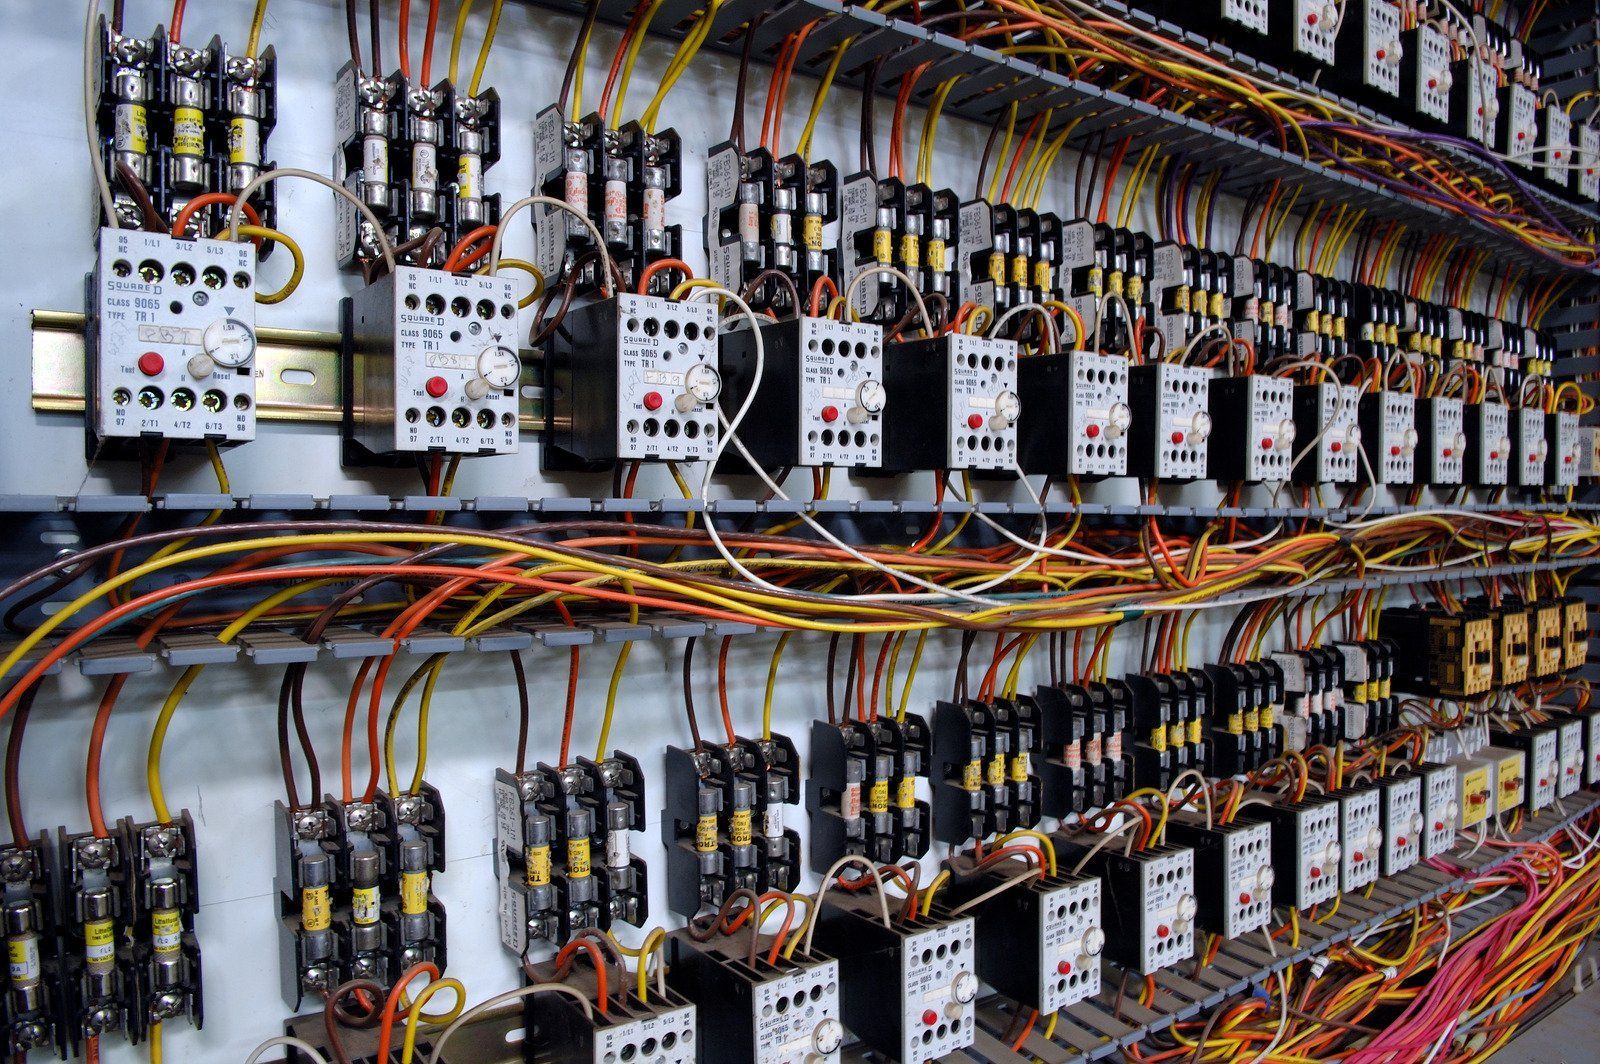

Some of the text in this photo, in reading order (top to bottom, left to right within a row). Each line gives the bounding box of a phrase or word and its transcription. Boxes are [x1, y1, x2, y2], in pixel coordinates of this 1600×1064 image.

[118, 236, 128, 244] 95
[144, 238, 160, 248] 1/L1
[176, 242, 192, 251] 3/L2
[207, 246, 224, 255] 5/L3
[108, 282, 162, 294] SQUARE D
[107, 298, 160, 309] CLASS 9065
[400, 314, 435, 323] SQUARE
[422, 329, 443, 339] 9065
[641, 349, 658, 358] 9065
[120, 366, 135, 374] Test
[212, 372, 230, 380] Reset
[205, 422, 222, 430] 6/T3
